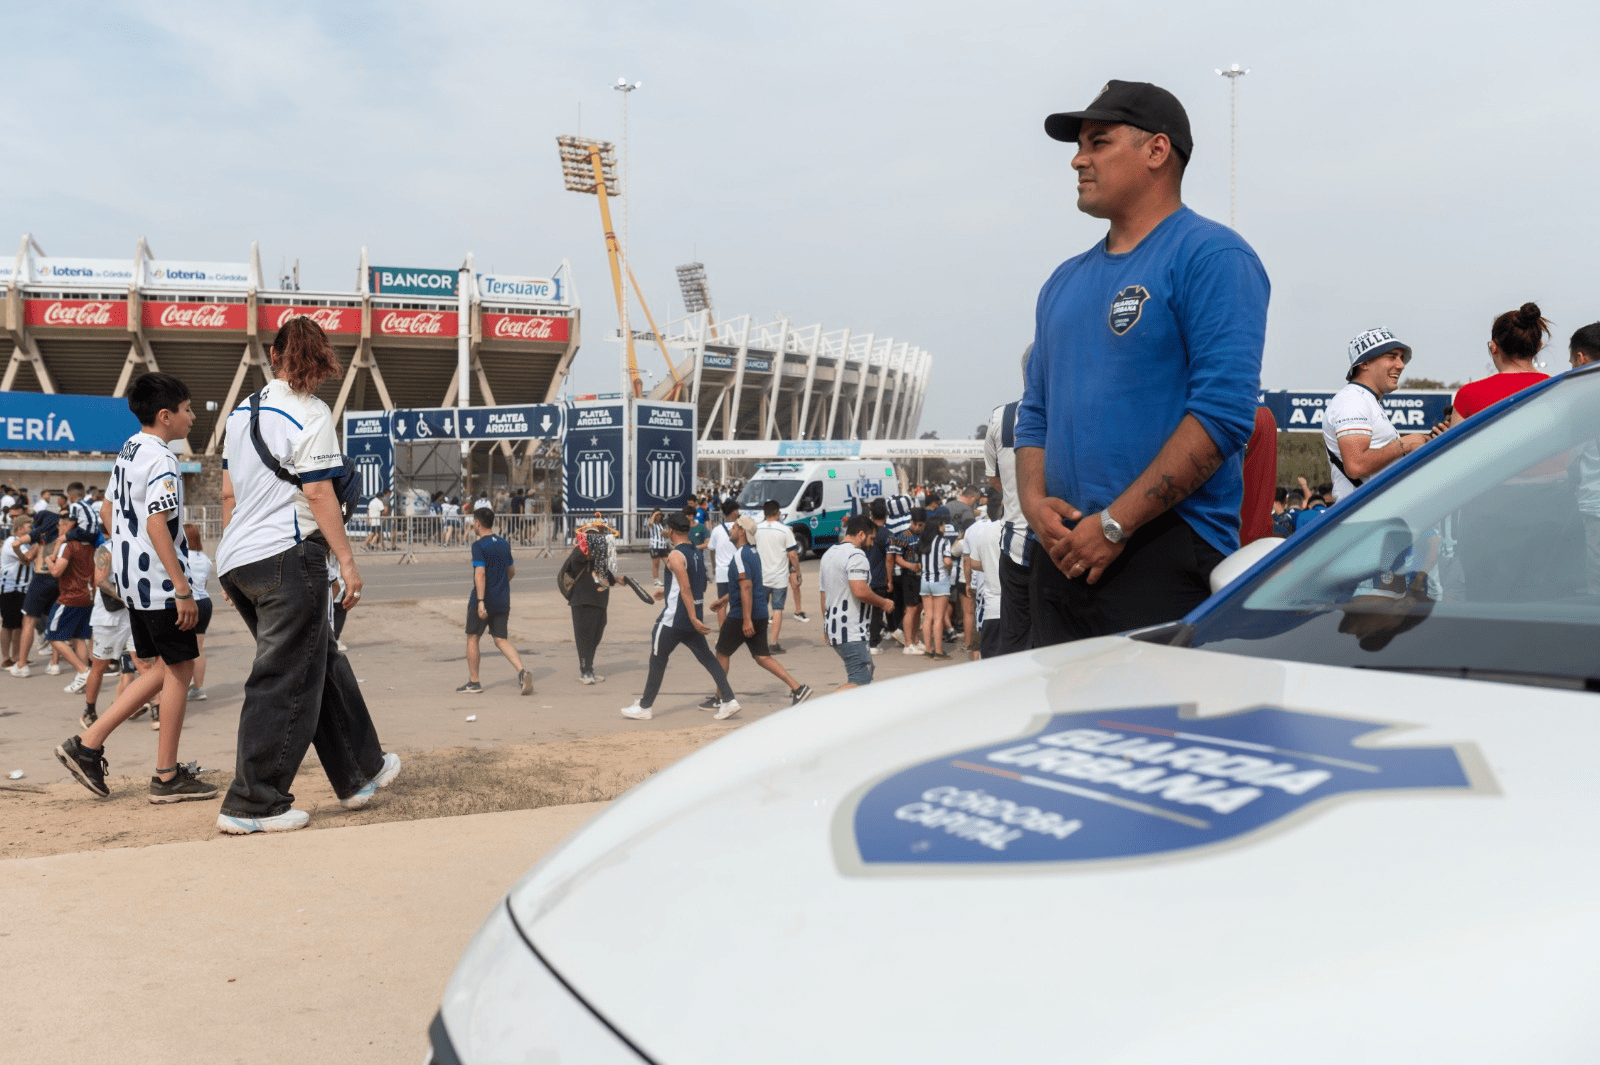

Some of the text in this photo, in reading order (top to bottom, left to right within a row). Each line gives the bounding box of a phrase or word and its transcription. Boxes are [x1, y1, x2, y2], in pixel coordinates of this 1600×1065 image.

[382, 271, 453, 289] BANCOR
[485, 277, 549, 296] Tersuave
[43, 302, 114, 325] Coca-Cola
[160, 304, 229, 327] Coca-Cola
[381, 311, 444, 334] Coca-Cola
[495, 316, 555, 339] Coca-Cola
[1291, 398, 1324, 407] SOLO
[1383, 399, 1424, 408] VENGO
[489, 413, 526, 424] PLATEA
[577, 416, 613, 427] ARDILES
[580, 409, 610, 418] PLATEA
[651, 409, 681, 418] PLATEA
[1289, 408, 1307, 424] A
[354, 426, 382, 434] ARDILES
[357, 419, 380, 427] PLATEA
[485, 422, 529, 434] ARDILES
[648, 417, 684, 427] ARDILES
[1037, 728, 1332, 796] GUARDIA
[986, 743, 1263, 815] URBANA
[894, 802, 1023, 850] CAPITAL
